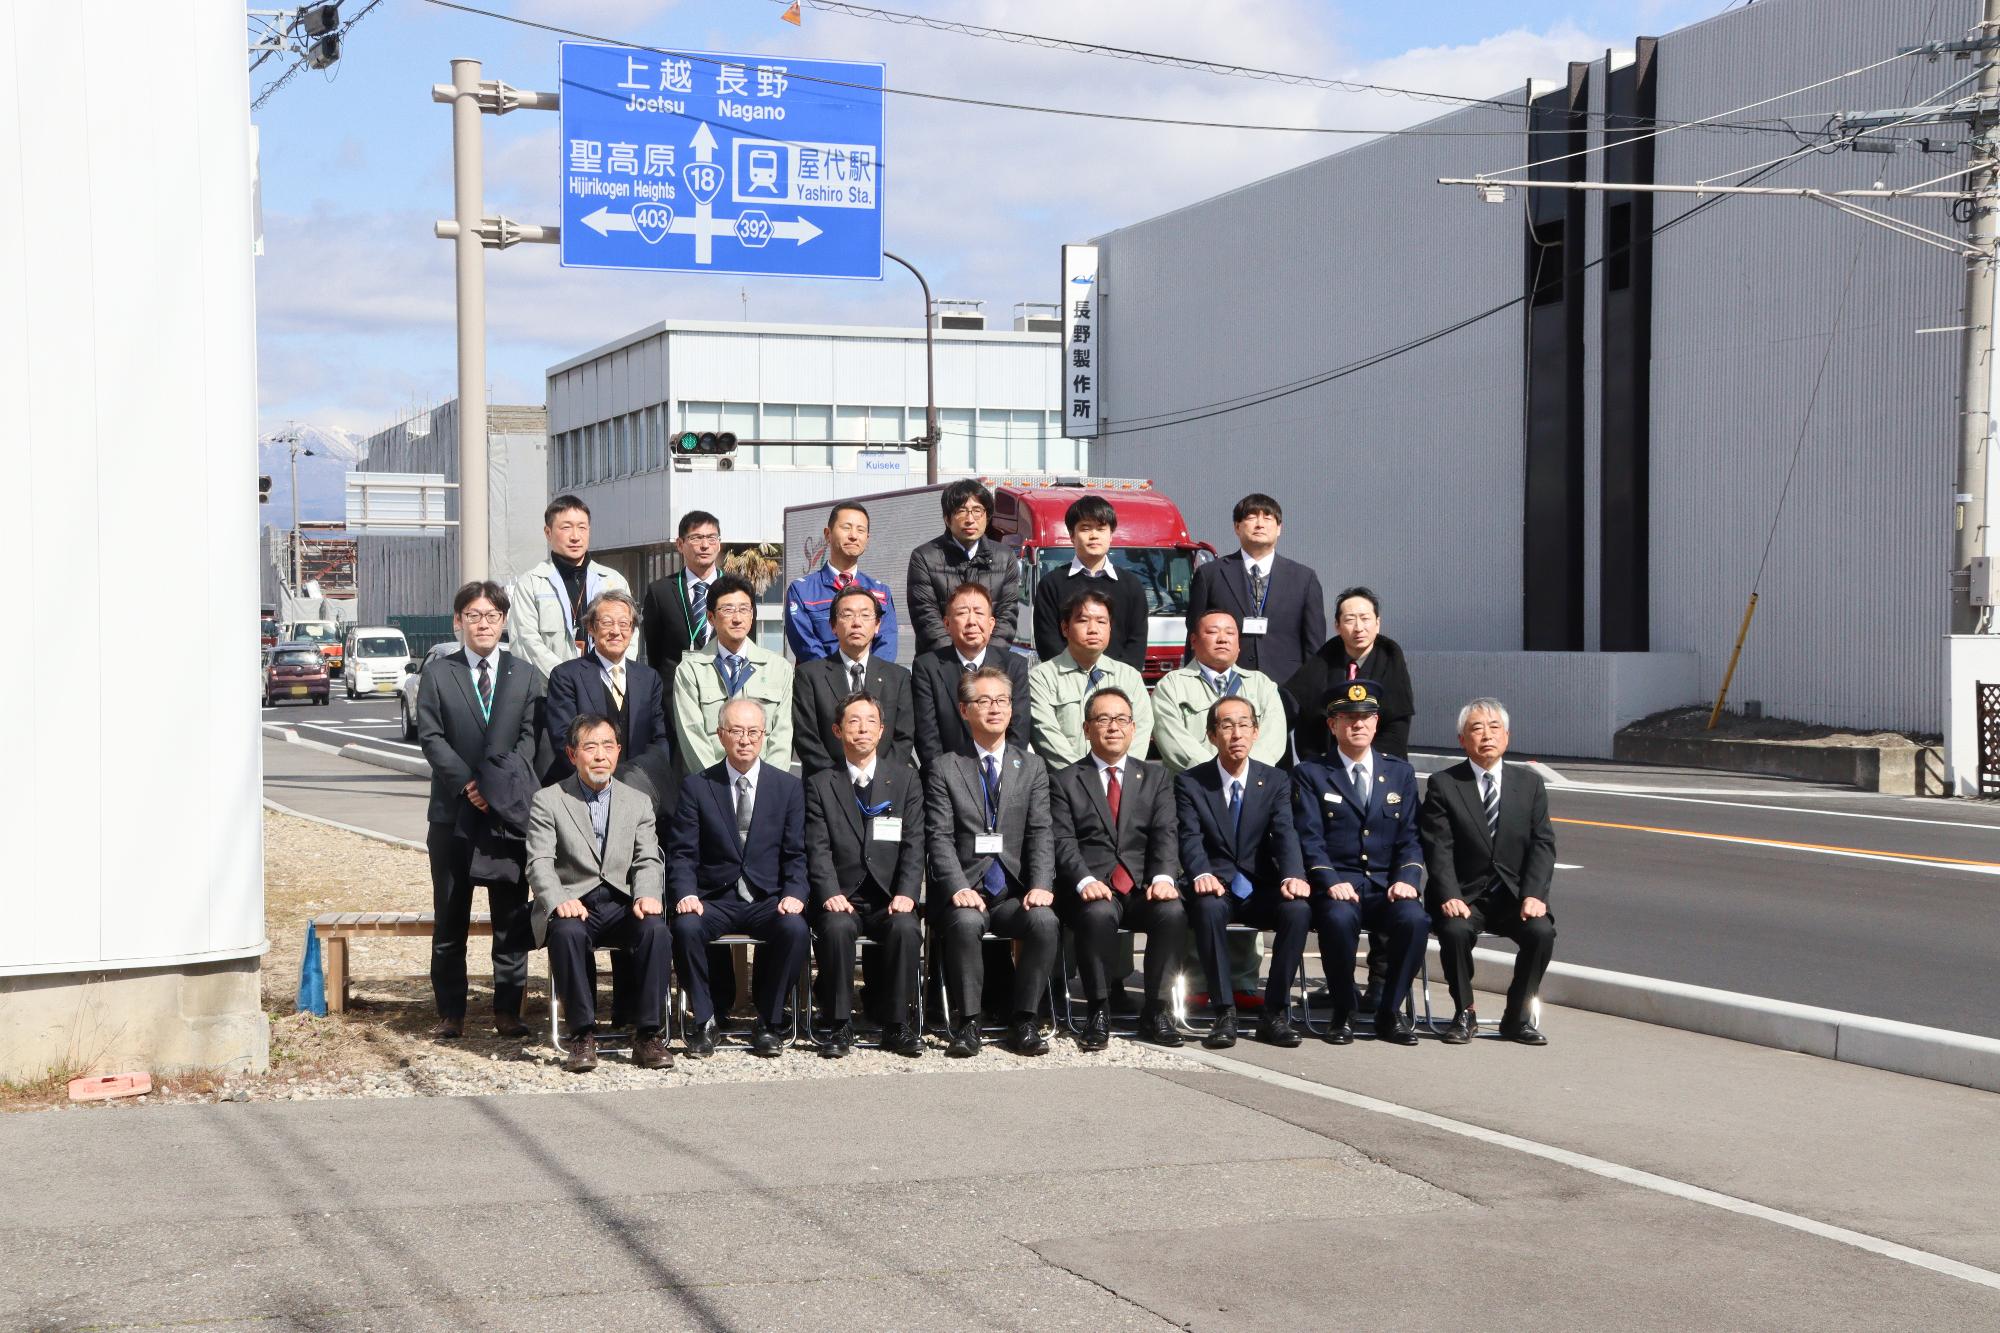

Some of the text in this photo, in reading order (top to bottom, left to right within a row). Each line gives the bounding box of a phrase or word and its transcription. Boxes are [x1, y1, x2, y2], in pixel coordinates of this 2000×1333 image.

[617, 55, 789, 99] 上越 長野
[625, 94, 786, 122] Joetsu Nagano
[569, 139, 676, 177] 聖高原
[797, 148, 871, 182] 屋代駅
[569, 176, 676, 201] Hijirikogen Heights
[690, 167, 716, 192] 18
[797, 183, 872, 205] Yashiro Sta.
[637, 208, 668, 229] 403
[740, 218, 768, 239] 392
[1072, 300, 1091, 419] 長野製作所
[866, 461, 900, 470] Kuiseke
